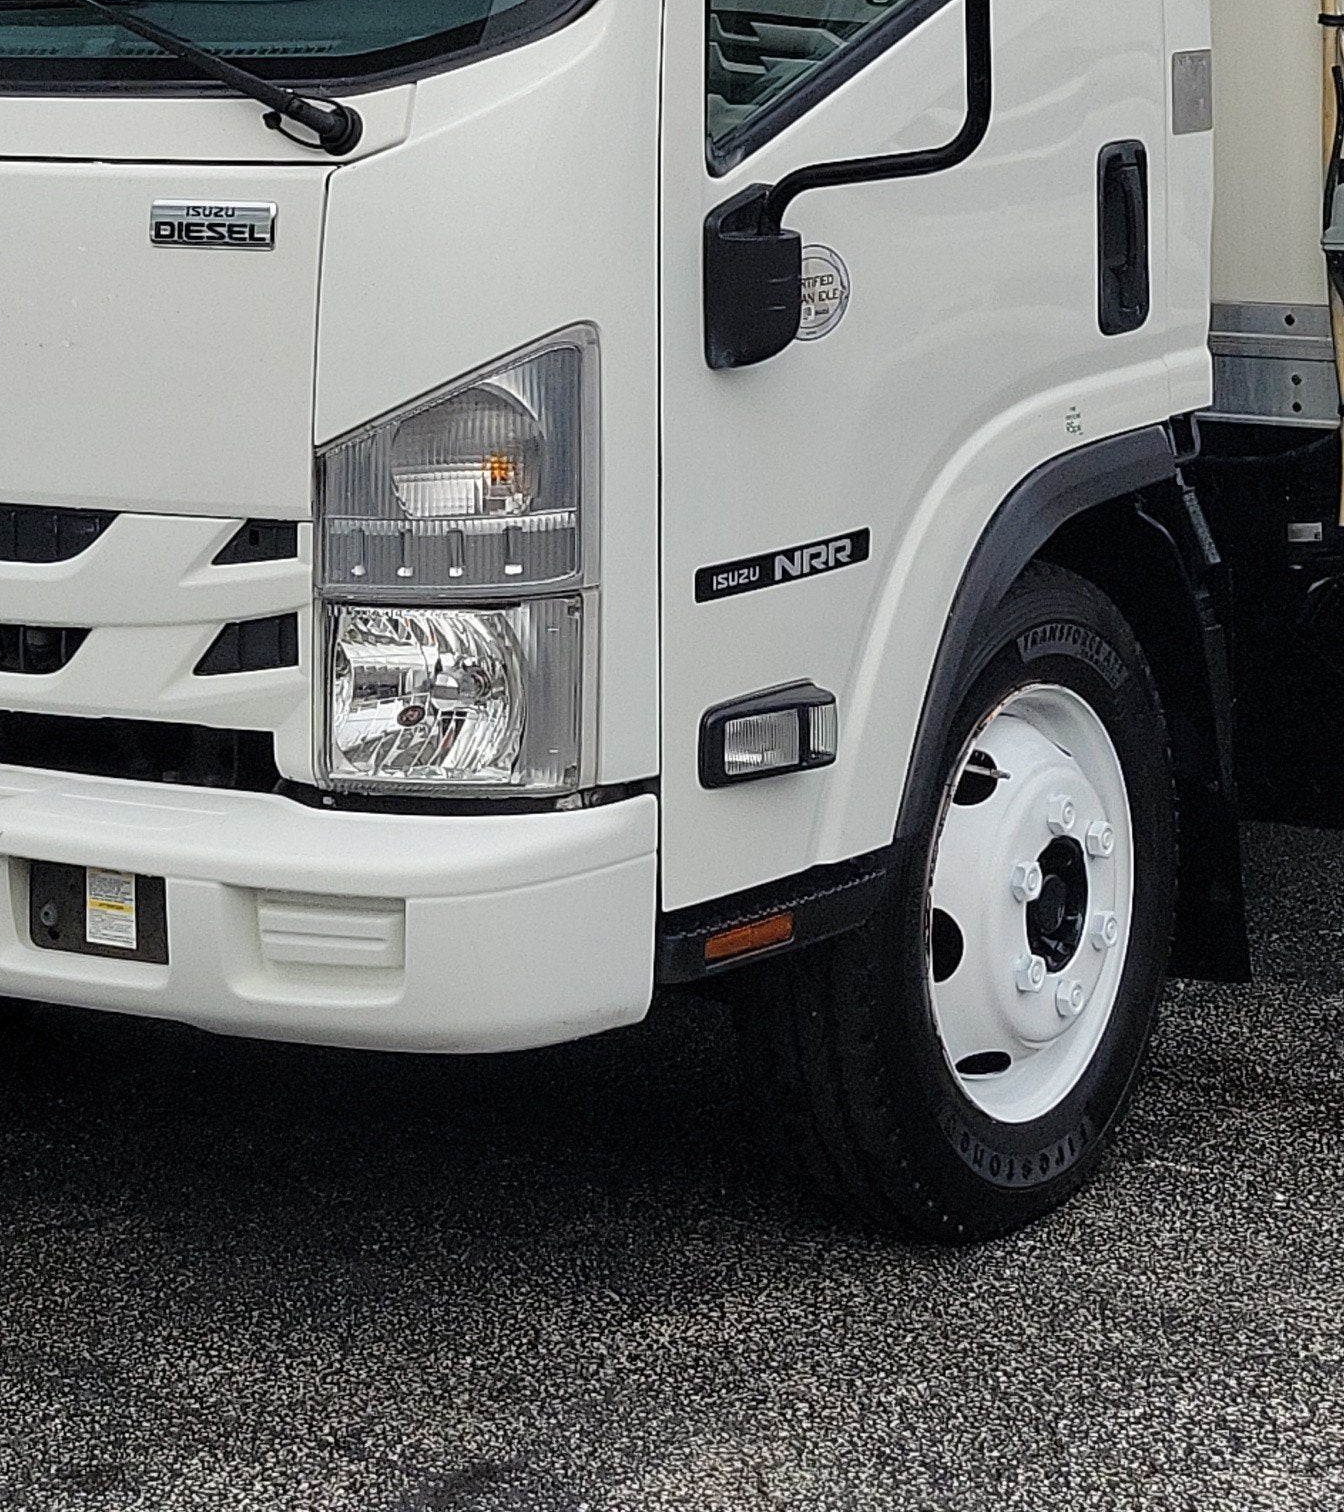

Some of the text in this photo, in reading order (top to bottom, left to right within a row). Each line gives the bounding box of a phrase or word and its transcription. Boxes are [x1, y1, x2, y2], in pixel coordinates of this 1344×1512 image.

[185, 206, 236, 218] ISUZU
[154, 220, 267, 242] DIESEL
[712, 538, 852, 591] ISUZU NRR
